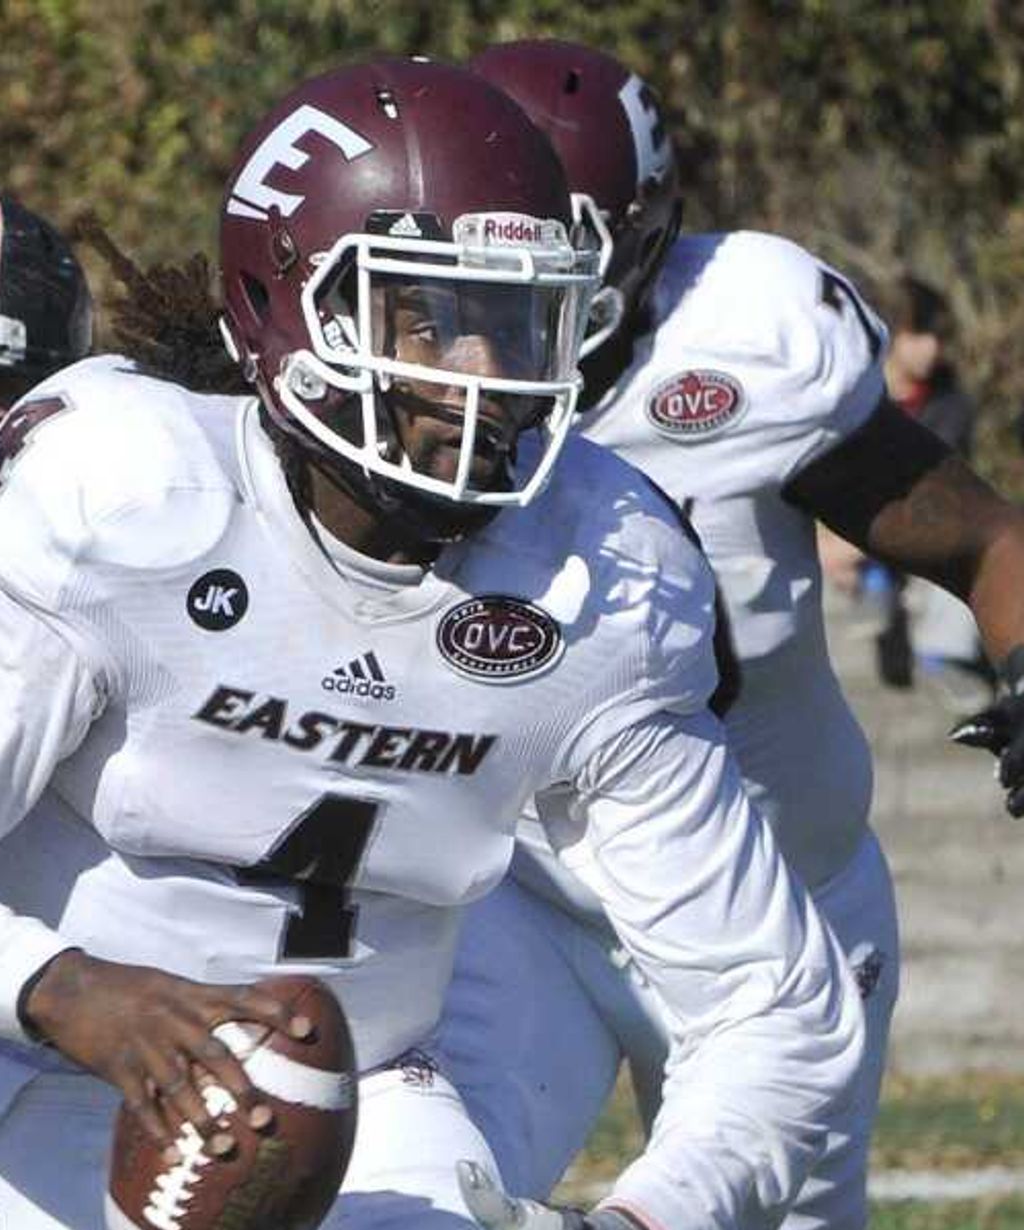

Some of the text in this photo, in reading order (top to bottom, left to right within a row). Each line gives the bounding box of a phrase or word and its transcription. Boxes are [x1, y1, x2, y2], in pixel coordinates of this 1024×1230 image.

[226, 103, 374, 219] E
[484, 218, 542, 242] Riddell
[666, 388, 719, 418] OVC
[193, 585, 239, 616] JK
[463, 622, 534, 652] OVC
[321, 676, 397, 701] adidas
[191, 683, 501, 777] EASTERN
[233, 791, 389, 963] 4
